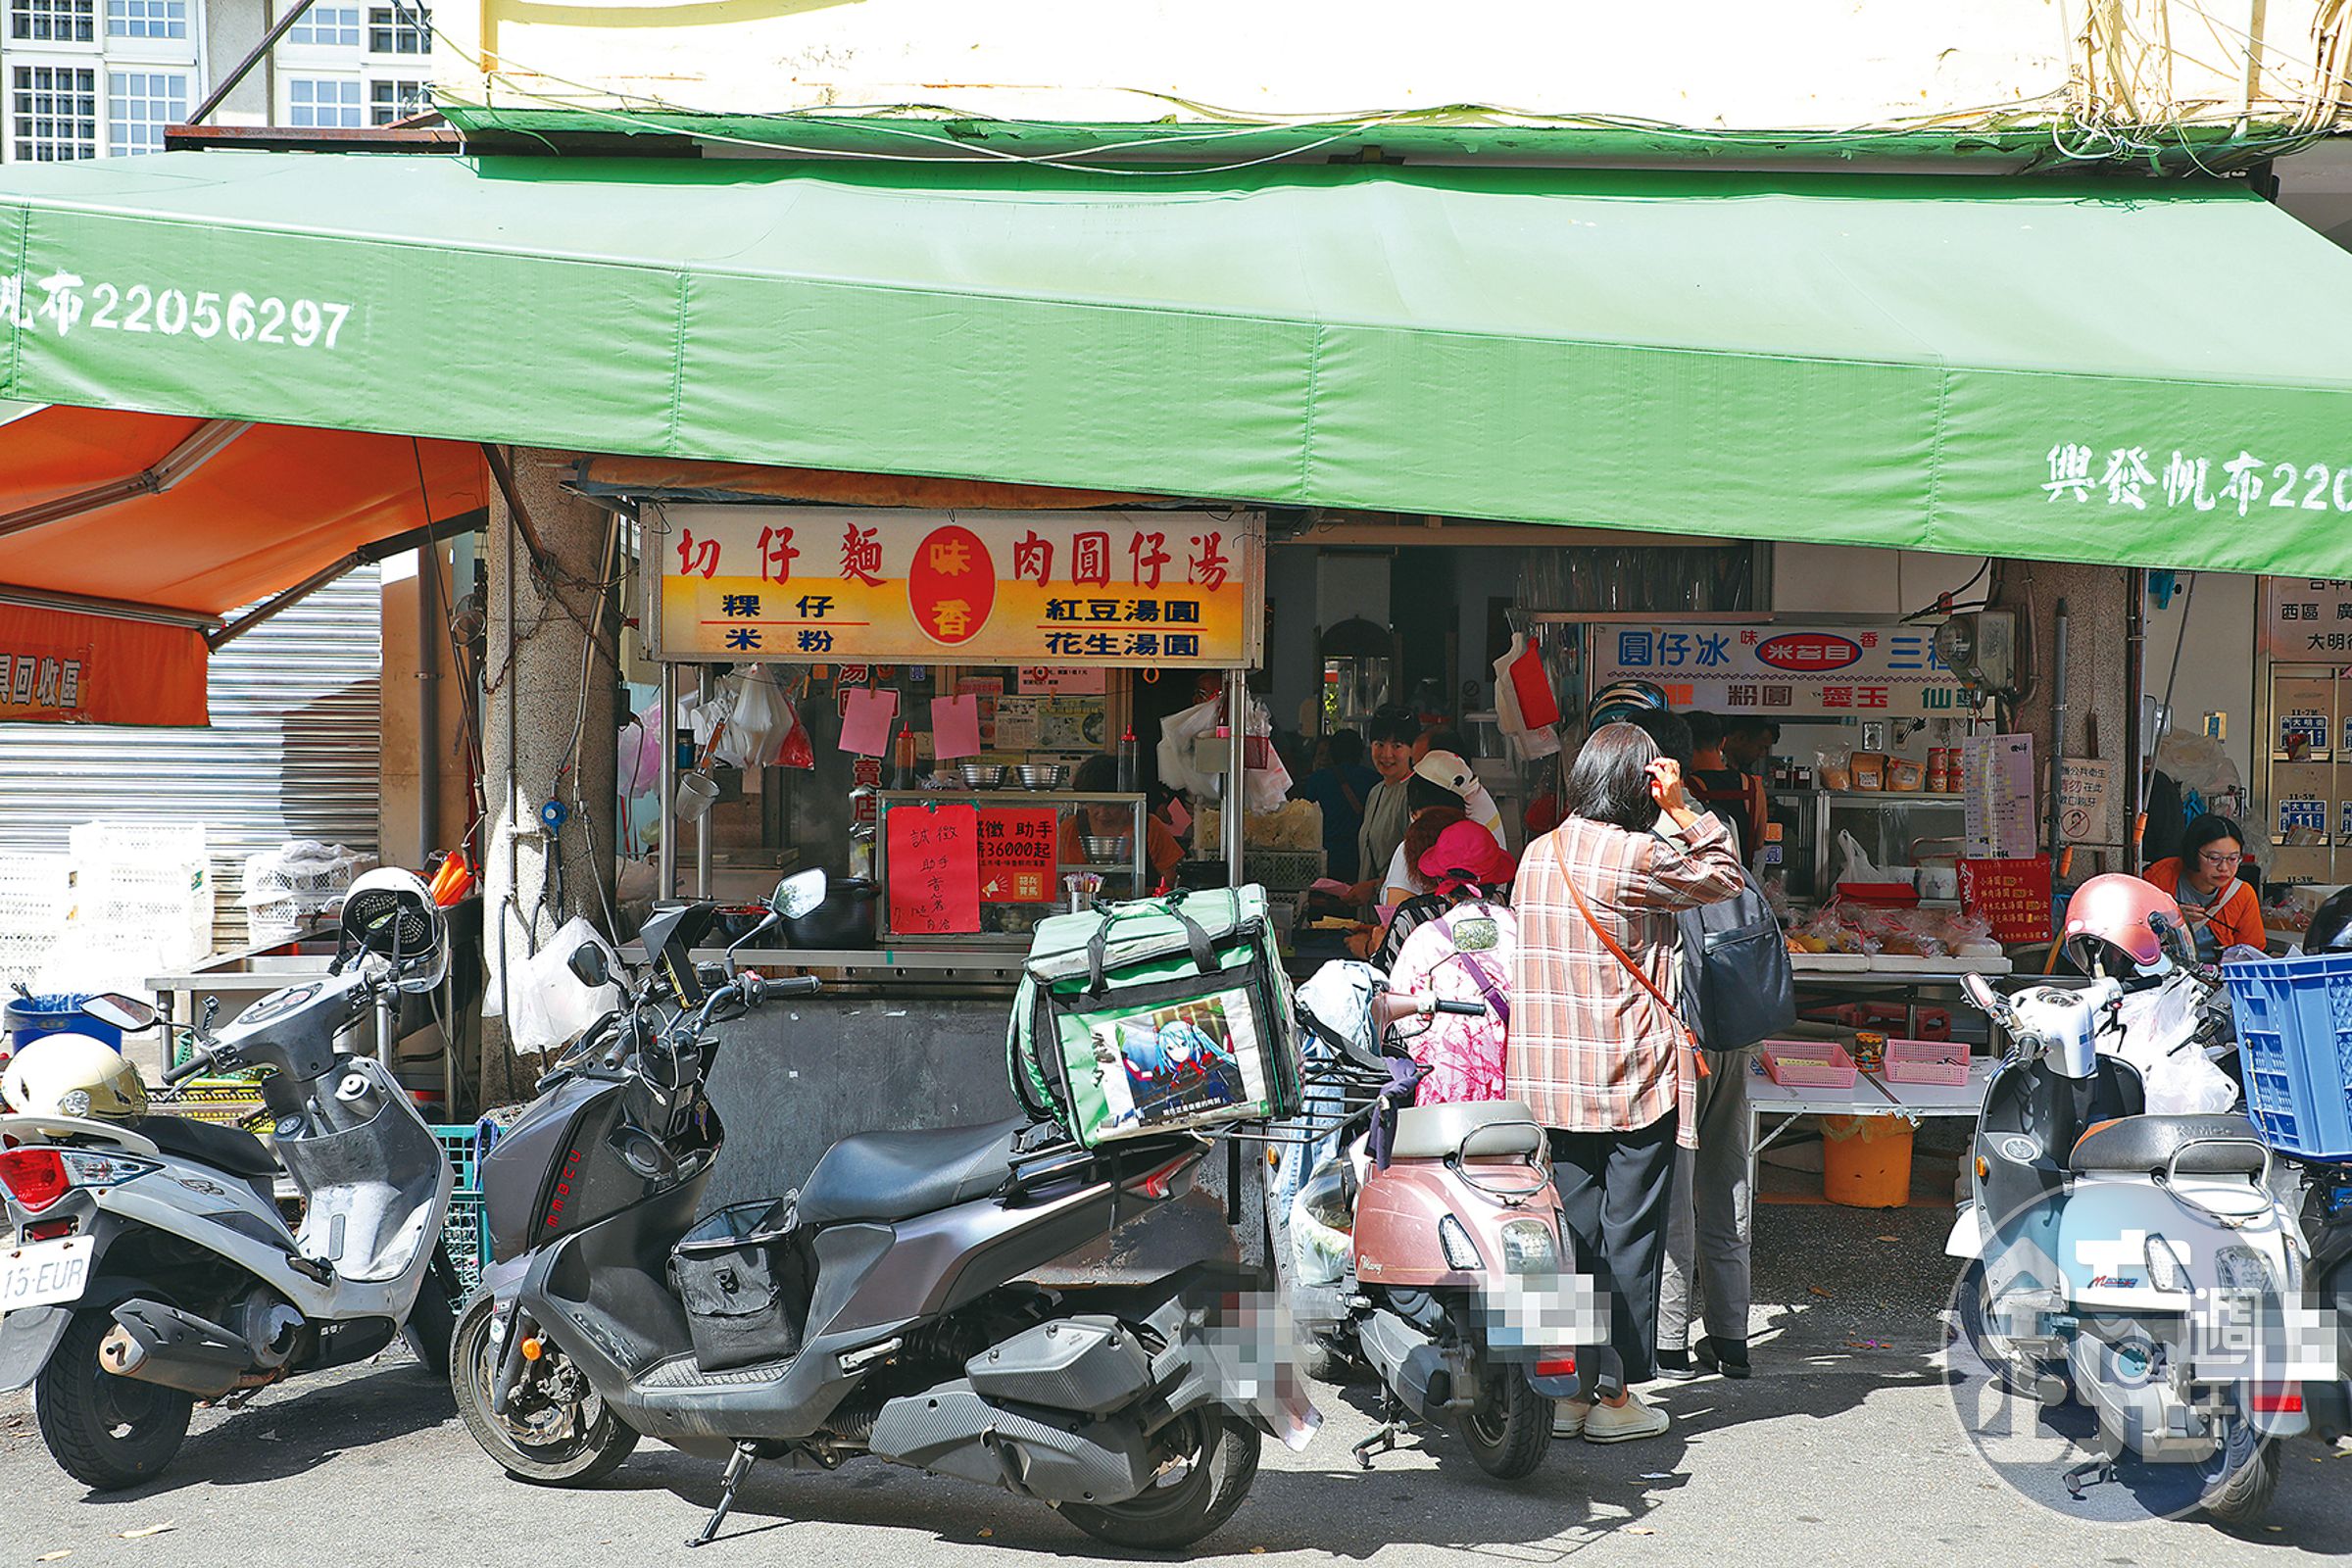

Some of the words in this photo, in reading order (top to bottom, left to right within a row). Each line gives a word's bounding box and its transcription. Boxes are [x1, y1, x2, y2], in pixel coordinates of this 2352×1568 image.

[677, 522, 887, 588] 切仔麵
[1013, 530, 1229, 591] 肉圓仔湯
[930, 539, 972, 636] 味香
[722, 594, 834, 618] 粿仔
[1046, 598, 1200, 623] 紅豆湯圓
[2281, 604, 2319, 620] 西區
[725, 628, 834, 652] 米粉
[1045, 632, 1199, 657] 花生湯圓
[1618, 631, 1730, 666] 圓仔冰
[1768, 644, 1850, 661] 米苔目
[1728, 685, 1792, 706] 粉圓
[1822, 686, 1887, 709] 愛玉
[1015, 820, 1053, 840] 助手
[546, 1150, 581, 1228] MMBCU
